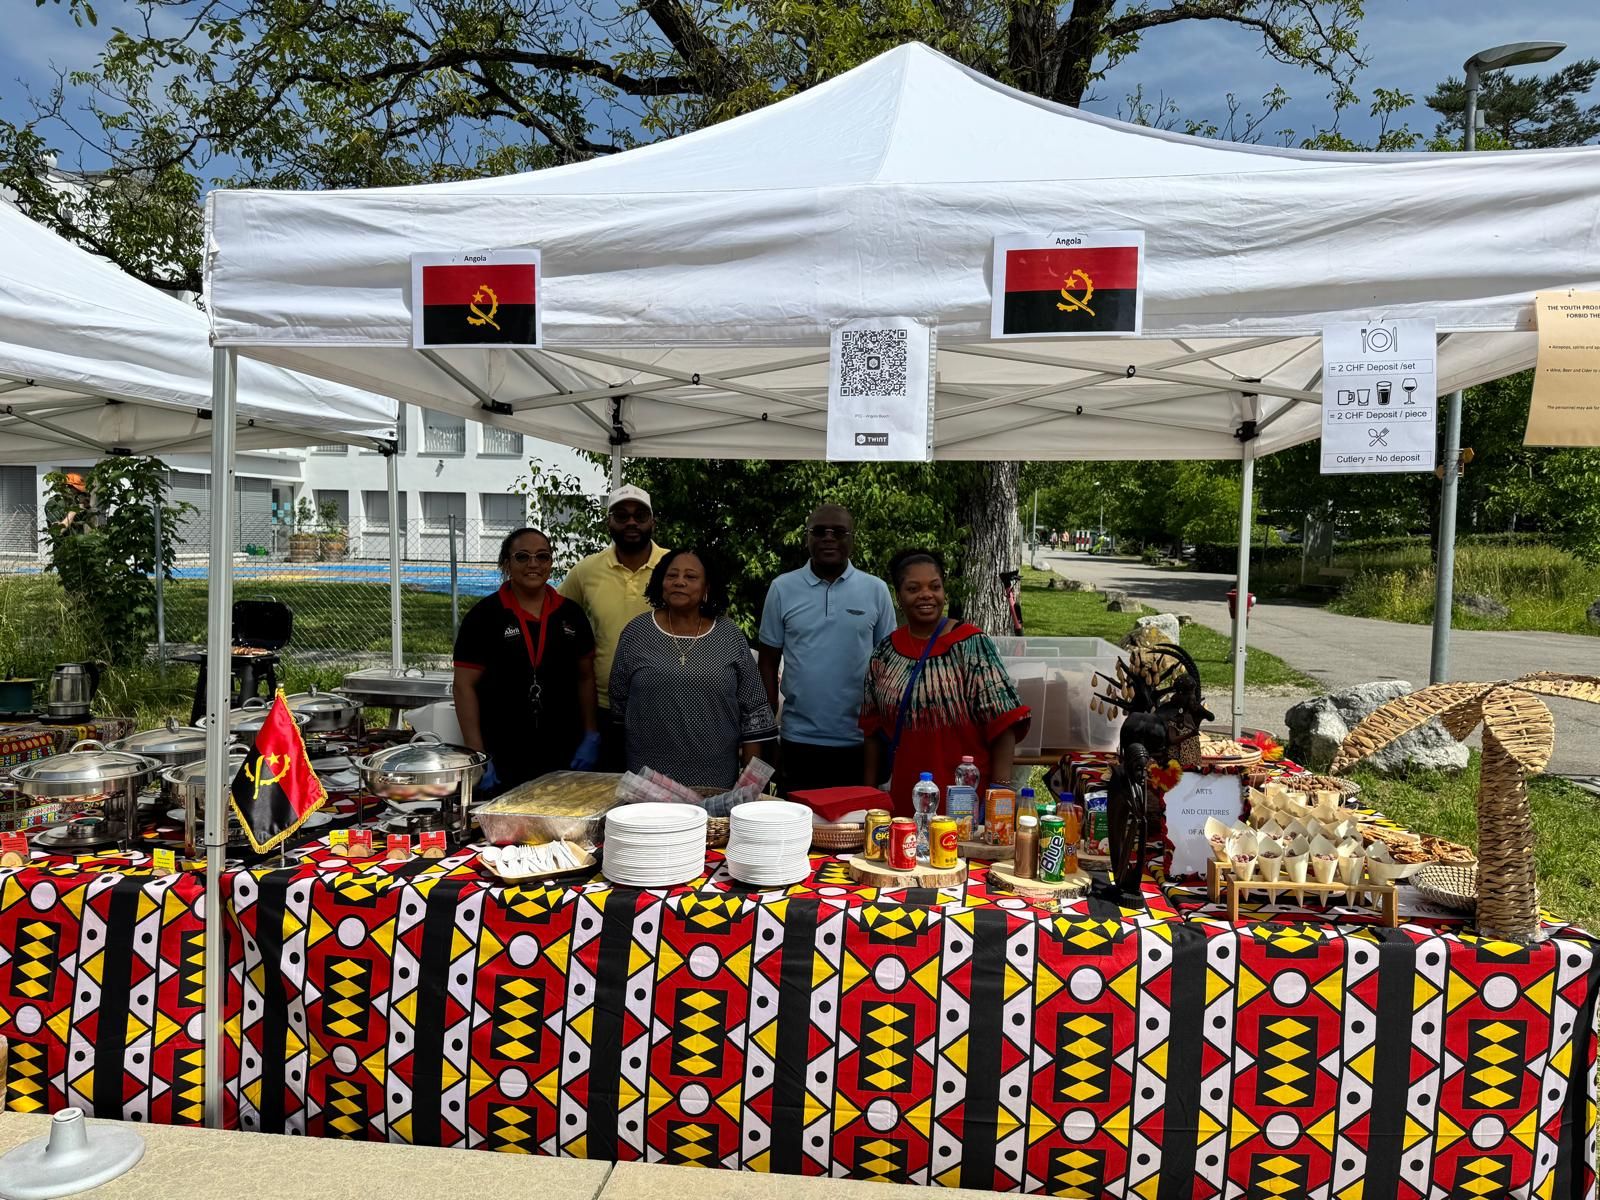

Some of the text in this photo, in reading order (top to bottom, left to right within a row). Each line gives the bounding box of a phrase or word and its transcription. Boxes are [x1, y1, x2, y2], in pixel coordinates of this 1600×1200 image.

[1056, 237, 1082, 246] Angola
[1367, 363, 1398, 373] Deposit
[1366, 410, 1397, 420] Deposit
[1405, 410, 1427, 420] piece
[1336, 456, 1365, 464] Cutlery
[1390, 454, 1420, 463] deposit
[1041, 835, 1064, 873] Blue
